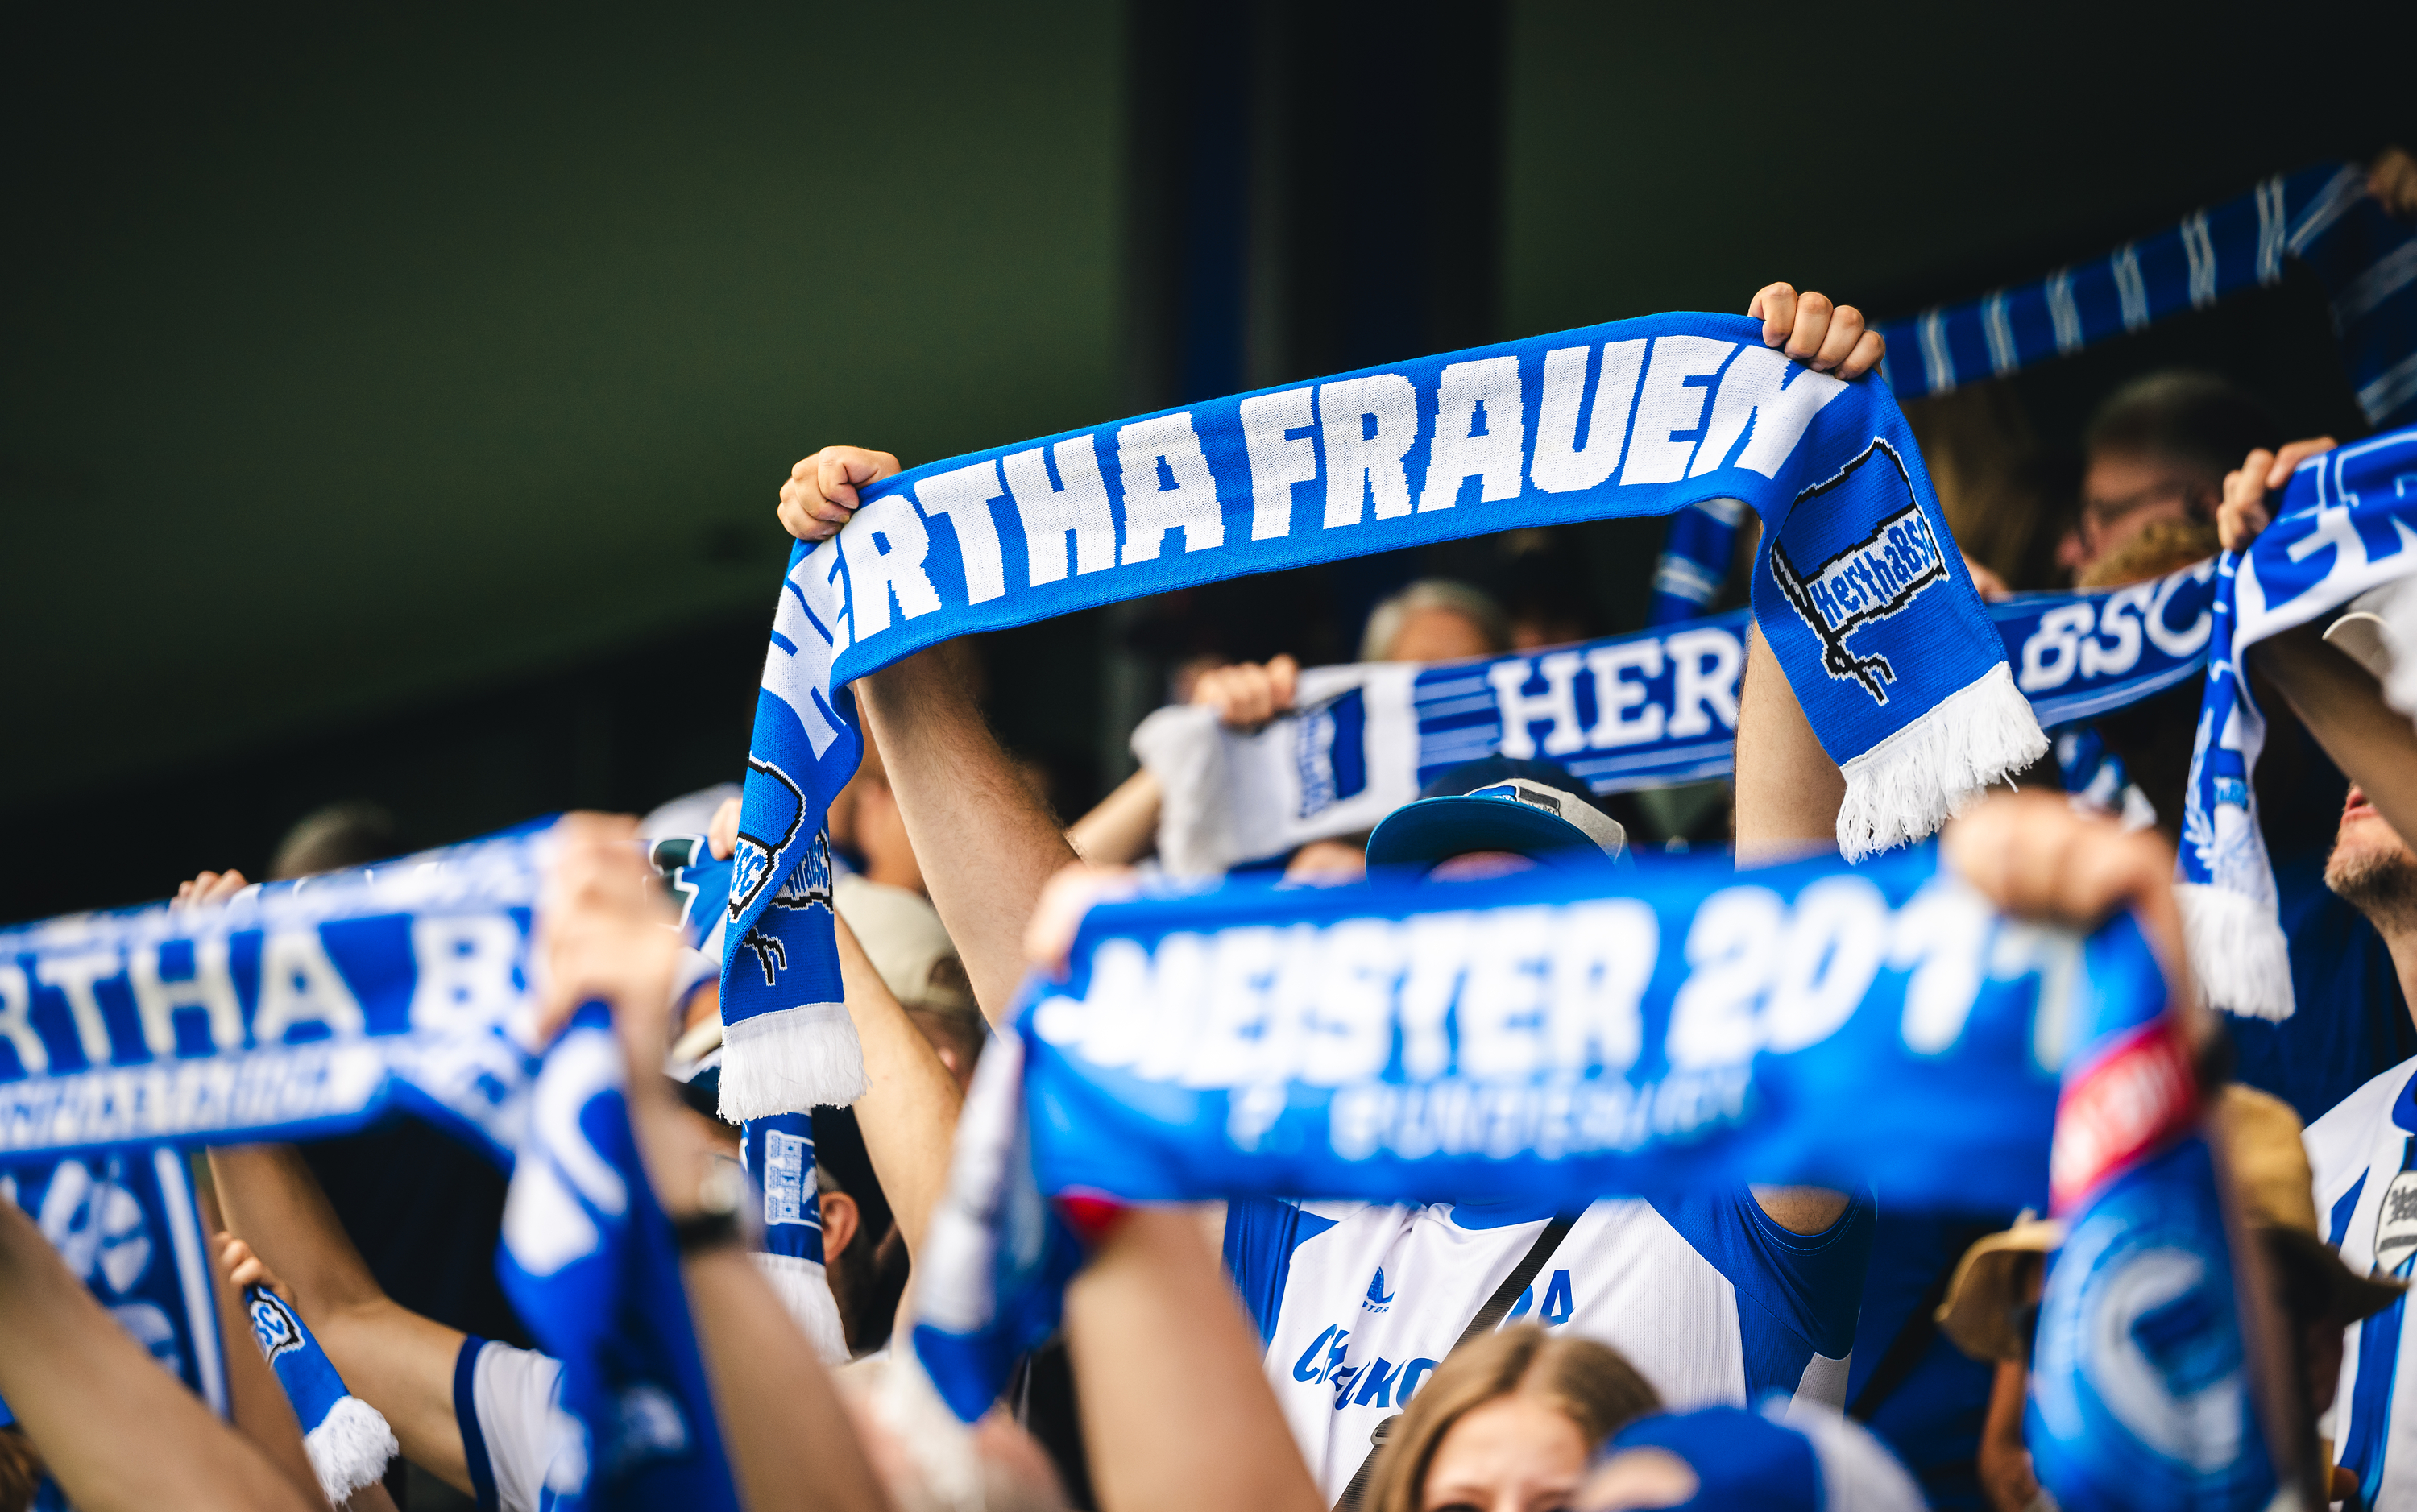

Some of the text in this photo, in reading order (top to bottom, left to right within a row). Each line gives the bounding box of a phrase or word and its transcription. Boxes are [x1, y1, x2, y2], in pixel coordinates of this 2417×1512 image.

[1241, 335, 1850, 541] FRAUEN
[1487, 628, 1742, 760] HER
[2019, 560, 2212, 693] BSC
[1034, 897, 1658, 1088] MEISTER
